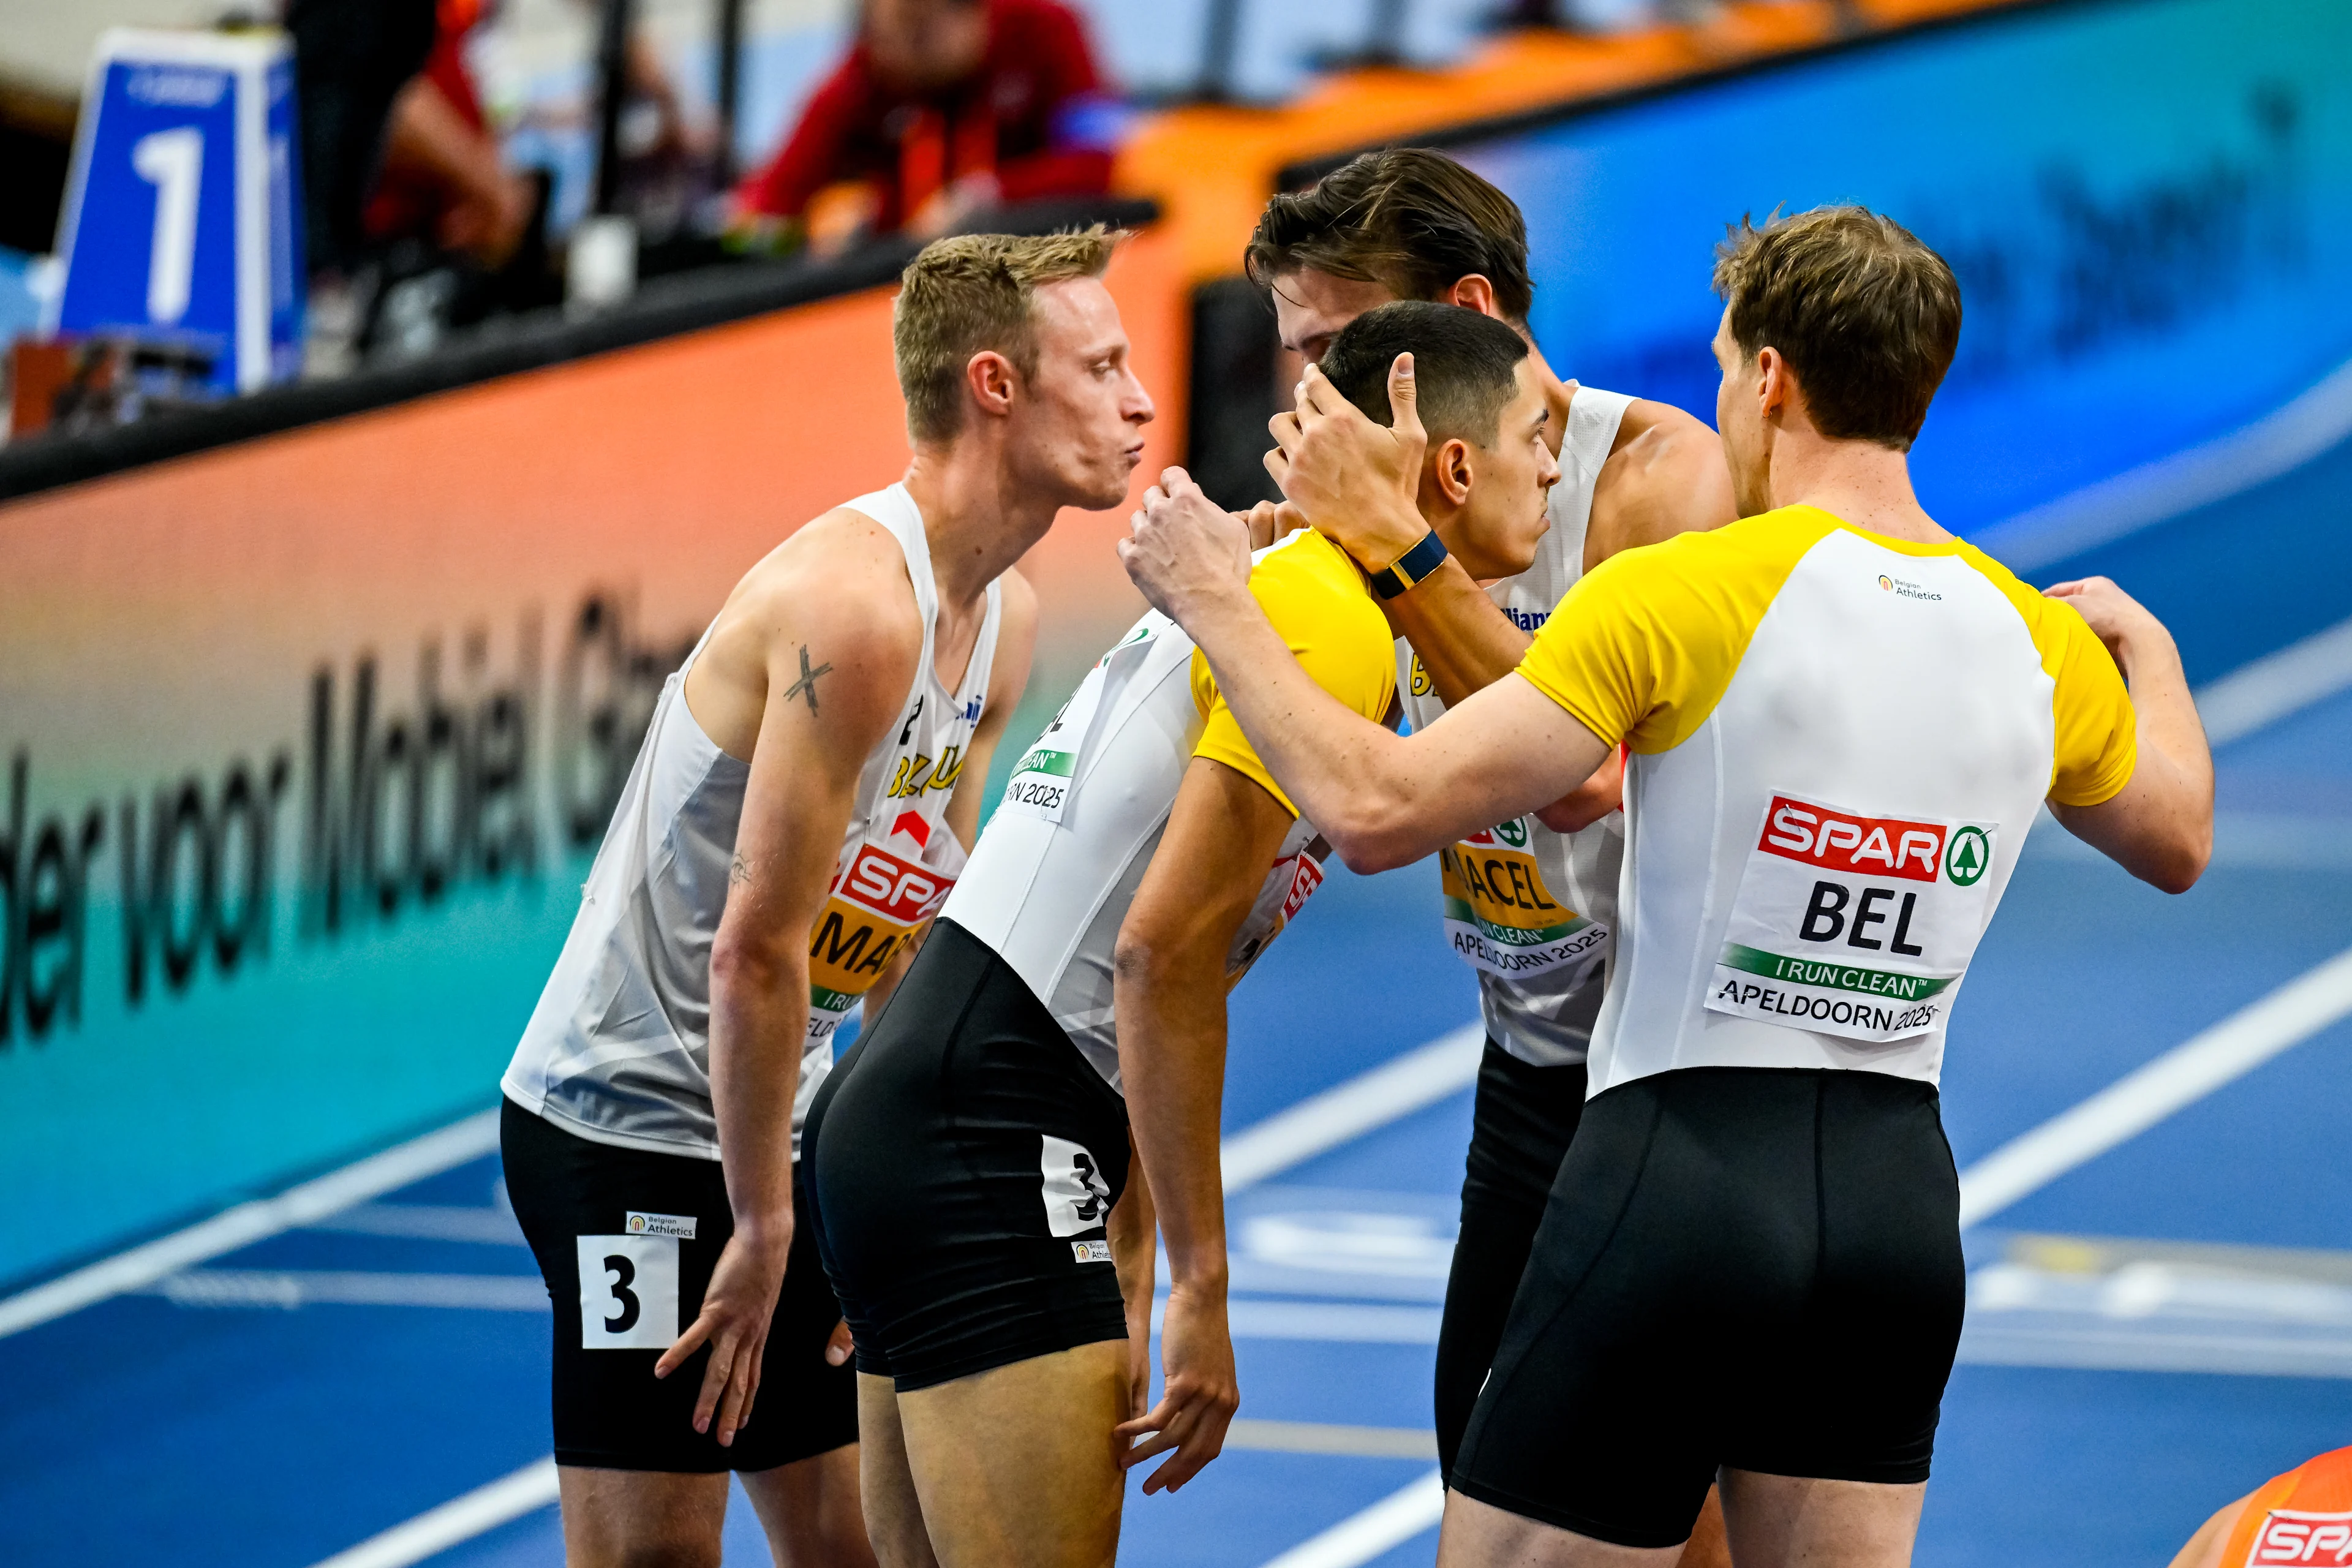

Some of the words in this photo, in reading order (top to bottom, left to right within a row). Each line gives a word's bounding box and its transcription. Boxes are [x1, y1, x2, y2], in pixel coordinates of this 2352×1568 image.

[132, 126, 205, 325] 1
[1894, 579, 1921, 589] Belgian
[1896, 587, 1942, 600] Athletics
[1022, 783, 1065, 809] 2025
[1768, 807, 1940, 873] SPAR
[1799, 880, 1923, 957] BEL
[1455, 932, 1555, 971] APELDOORN
[1551, 929, 1607, 960] 2025
[1776, 959, 1785, 977] I
[1787, 961, 1839, 985] RUN
[1717, 980, 1894, 1031] APELDOORN
[1894, 1005, 1934, 1031] 2025
[1073, 1153, 1101, 1221] 3
[647, 1224, 693, 1236] Athletics
[603, 1254, 641, 1334] 3
[2260, 1523, 2352, 1562] SP
